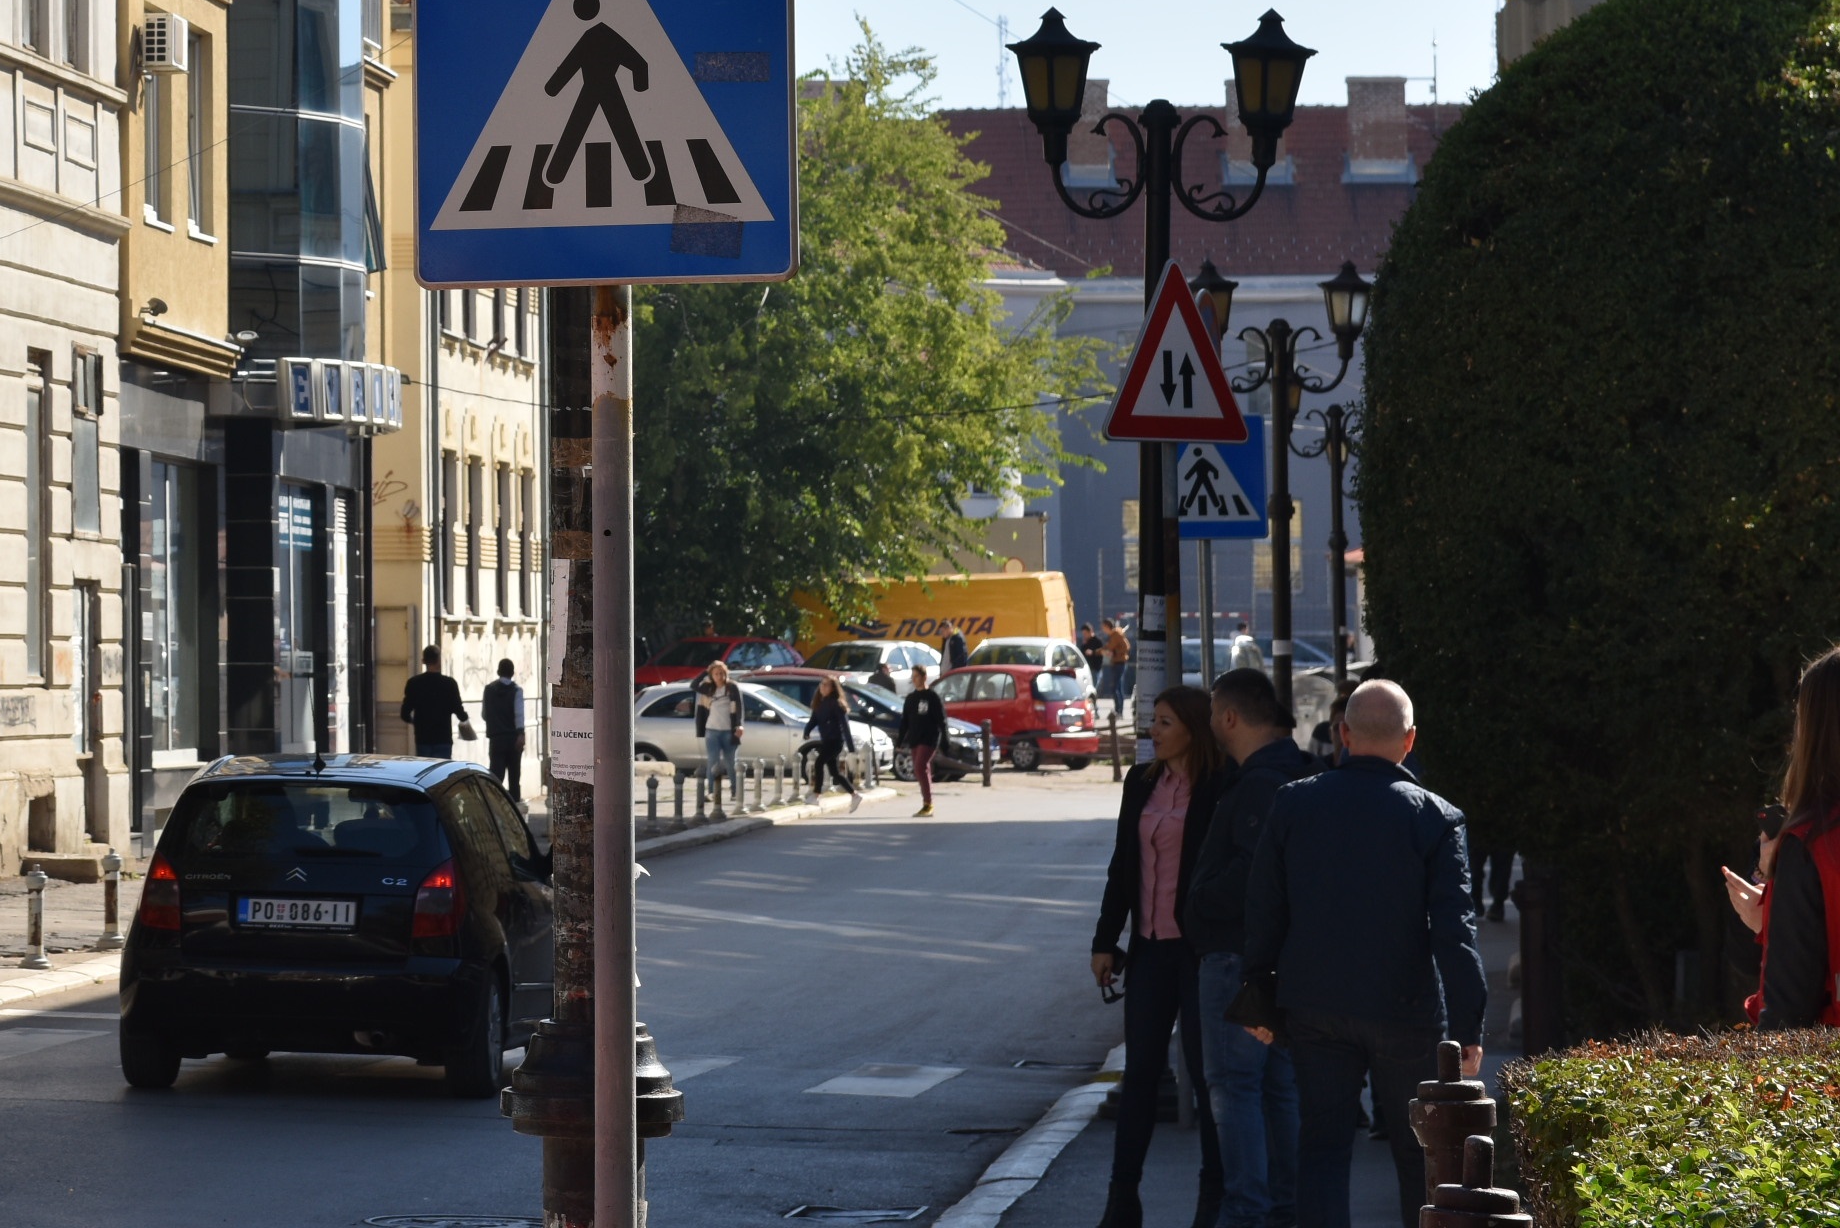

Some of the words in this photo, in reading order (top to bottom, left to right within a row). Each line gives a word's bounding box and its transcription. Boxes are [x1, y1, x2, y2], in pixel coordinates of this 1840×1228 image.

[564, 729, 593, 739] UČENIC
[569, 763, 595, 771] opremljen
[381, 877, 408, 886] C2
[251, 901, 274, 920] PO
